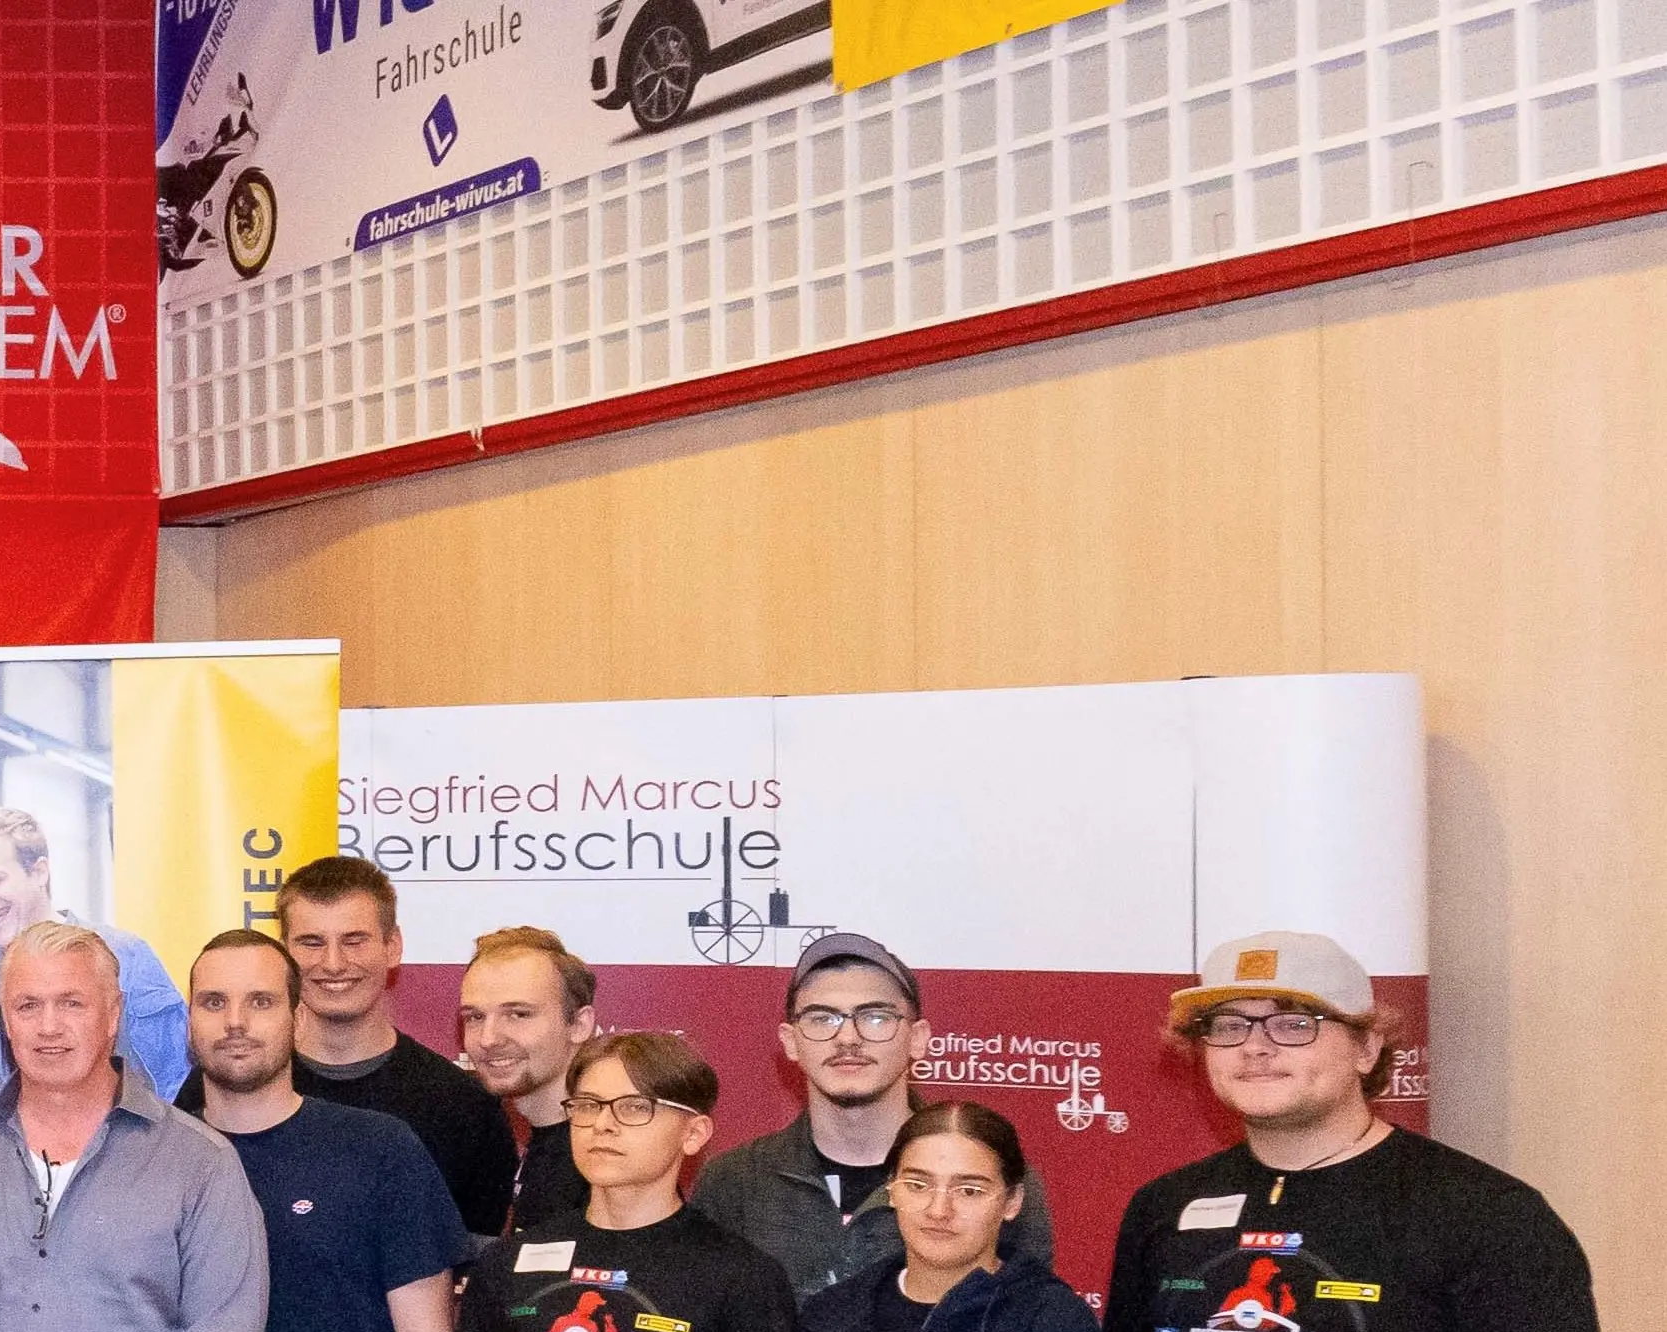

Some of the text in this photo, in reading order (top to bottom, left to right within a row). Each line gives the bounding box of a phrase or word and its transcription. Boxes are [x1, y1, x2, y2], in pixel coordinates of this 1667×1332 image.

[375, 9, 523, 99] Fahrschule
[368, 169, 525, 243] fahrschule-wivus.at
[338, 773, 782, 825] Siegfried Marcus
[928, 1033, 1102, 1059] gfried Marcus
[910, 1055, 1101, 1087] erufsschule
[1239, 1232, 1285, 1246] WKO
[570, 1267, 612, 1282] WKO
